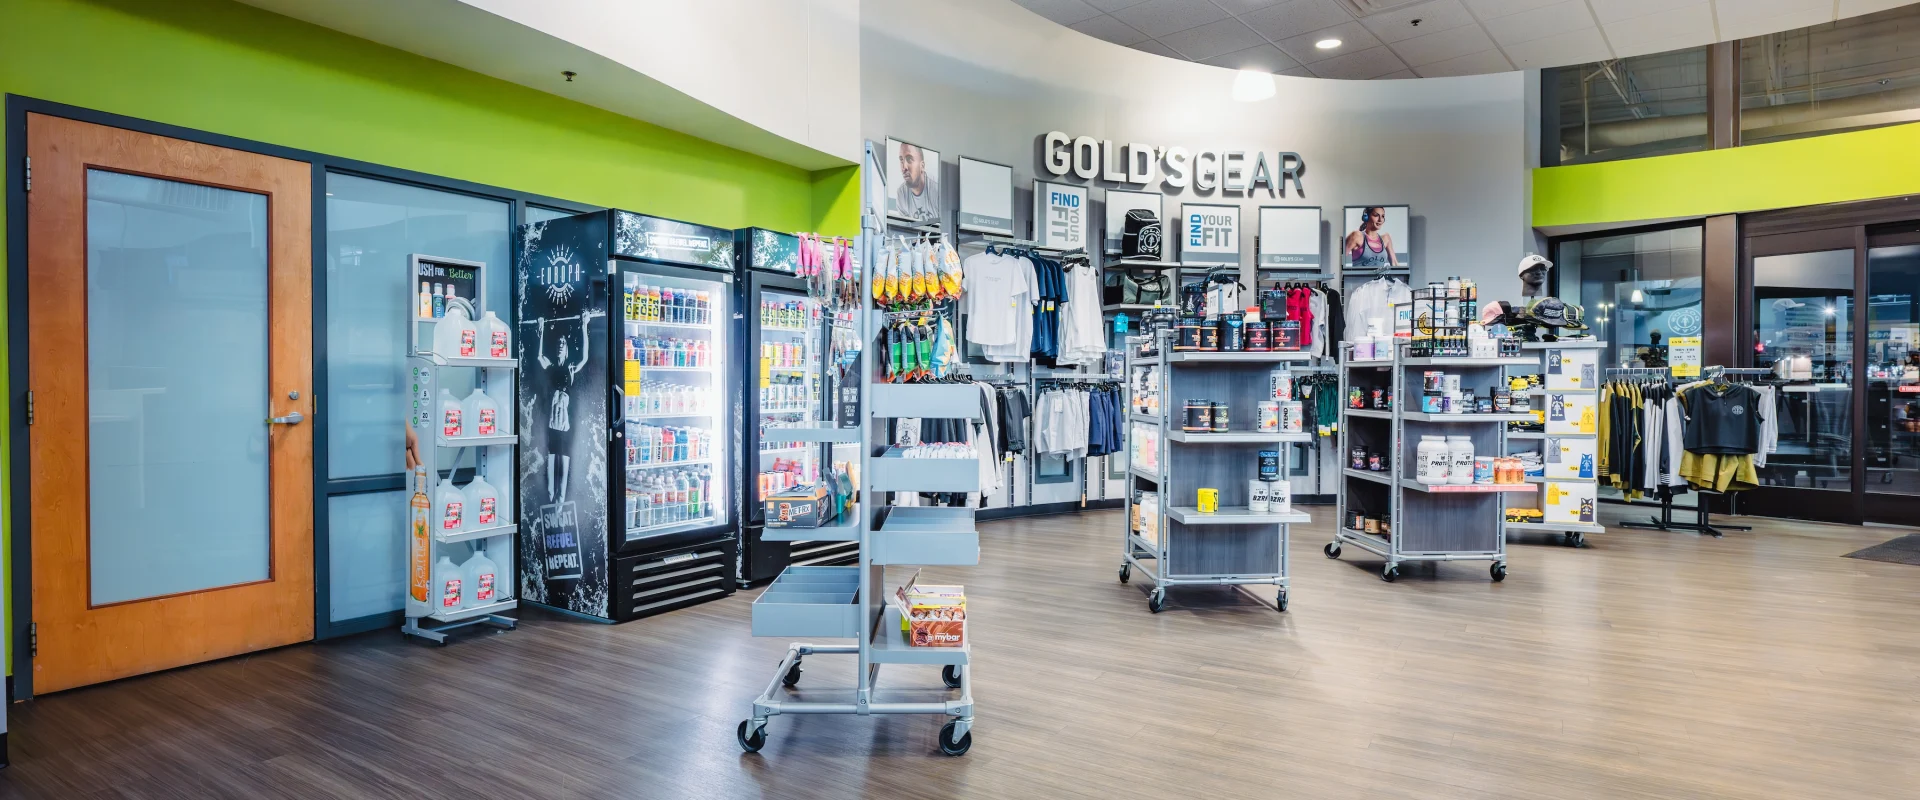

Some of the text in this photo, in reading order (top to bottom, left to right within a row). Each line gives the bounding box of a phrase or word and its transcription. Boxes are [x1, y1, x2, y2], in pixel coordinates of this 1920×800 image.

[1045, 130, 1302, 191] GOLD'S GEAR
[1051, 191, 1080, 208] FIND
[1051, 206, 1069, 242] FIT
[1070, 207, 1080, 243] YOUR
[1201, 214, 1233, 226] YOUR
[1190, 214, 1202, 247] FIND
[1202, 227, 1233, 247] FIT
[434, 267, 445, 277] FOR
[449, 267, 474, 280] Better
[541, 262, 580, 286] EUROPA
[543, 510, 575, 530] SWEAT.
[546, 532, 577, 550] REFUEL.
[414, 537, 424, 588] karma
[547, 552, 580, 571] REPEAT.
[934, 633, 961, 643] mybar
